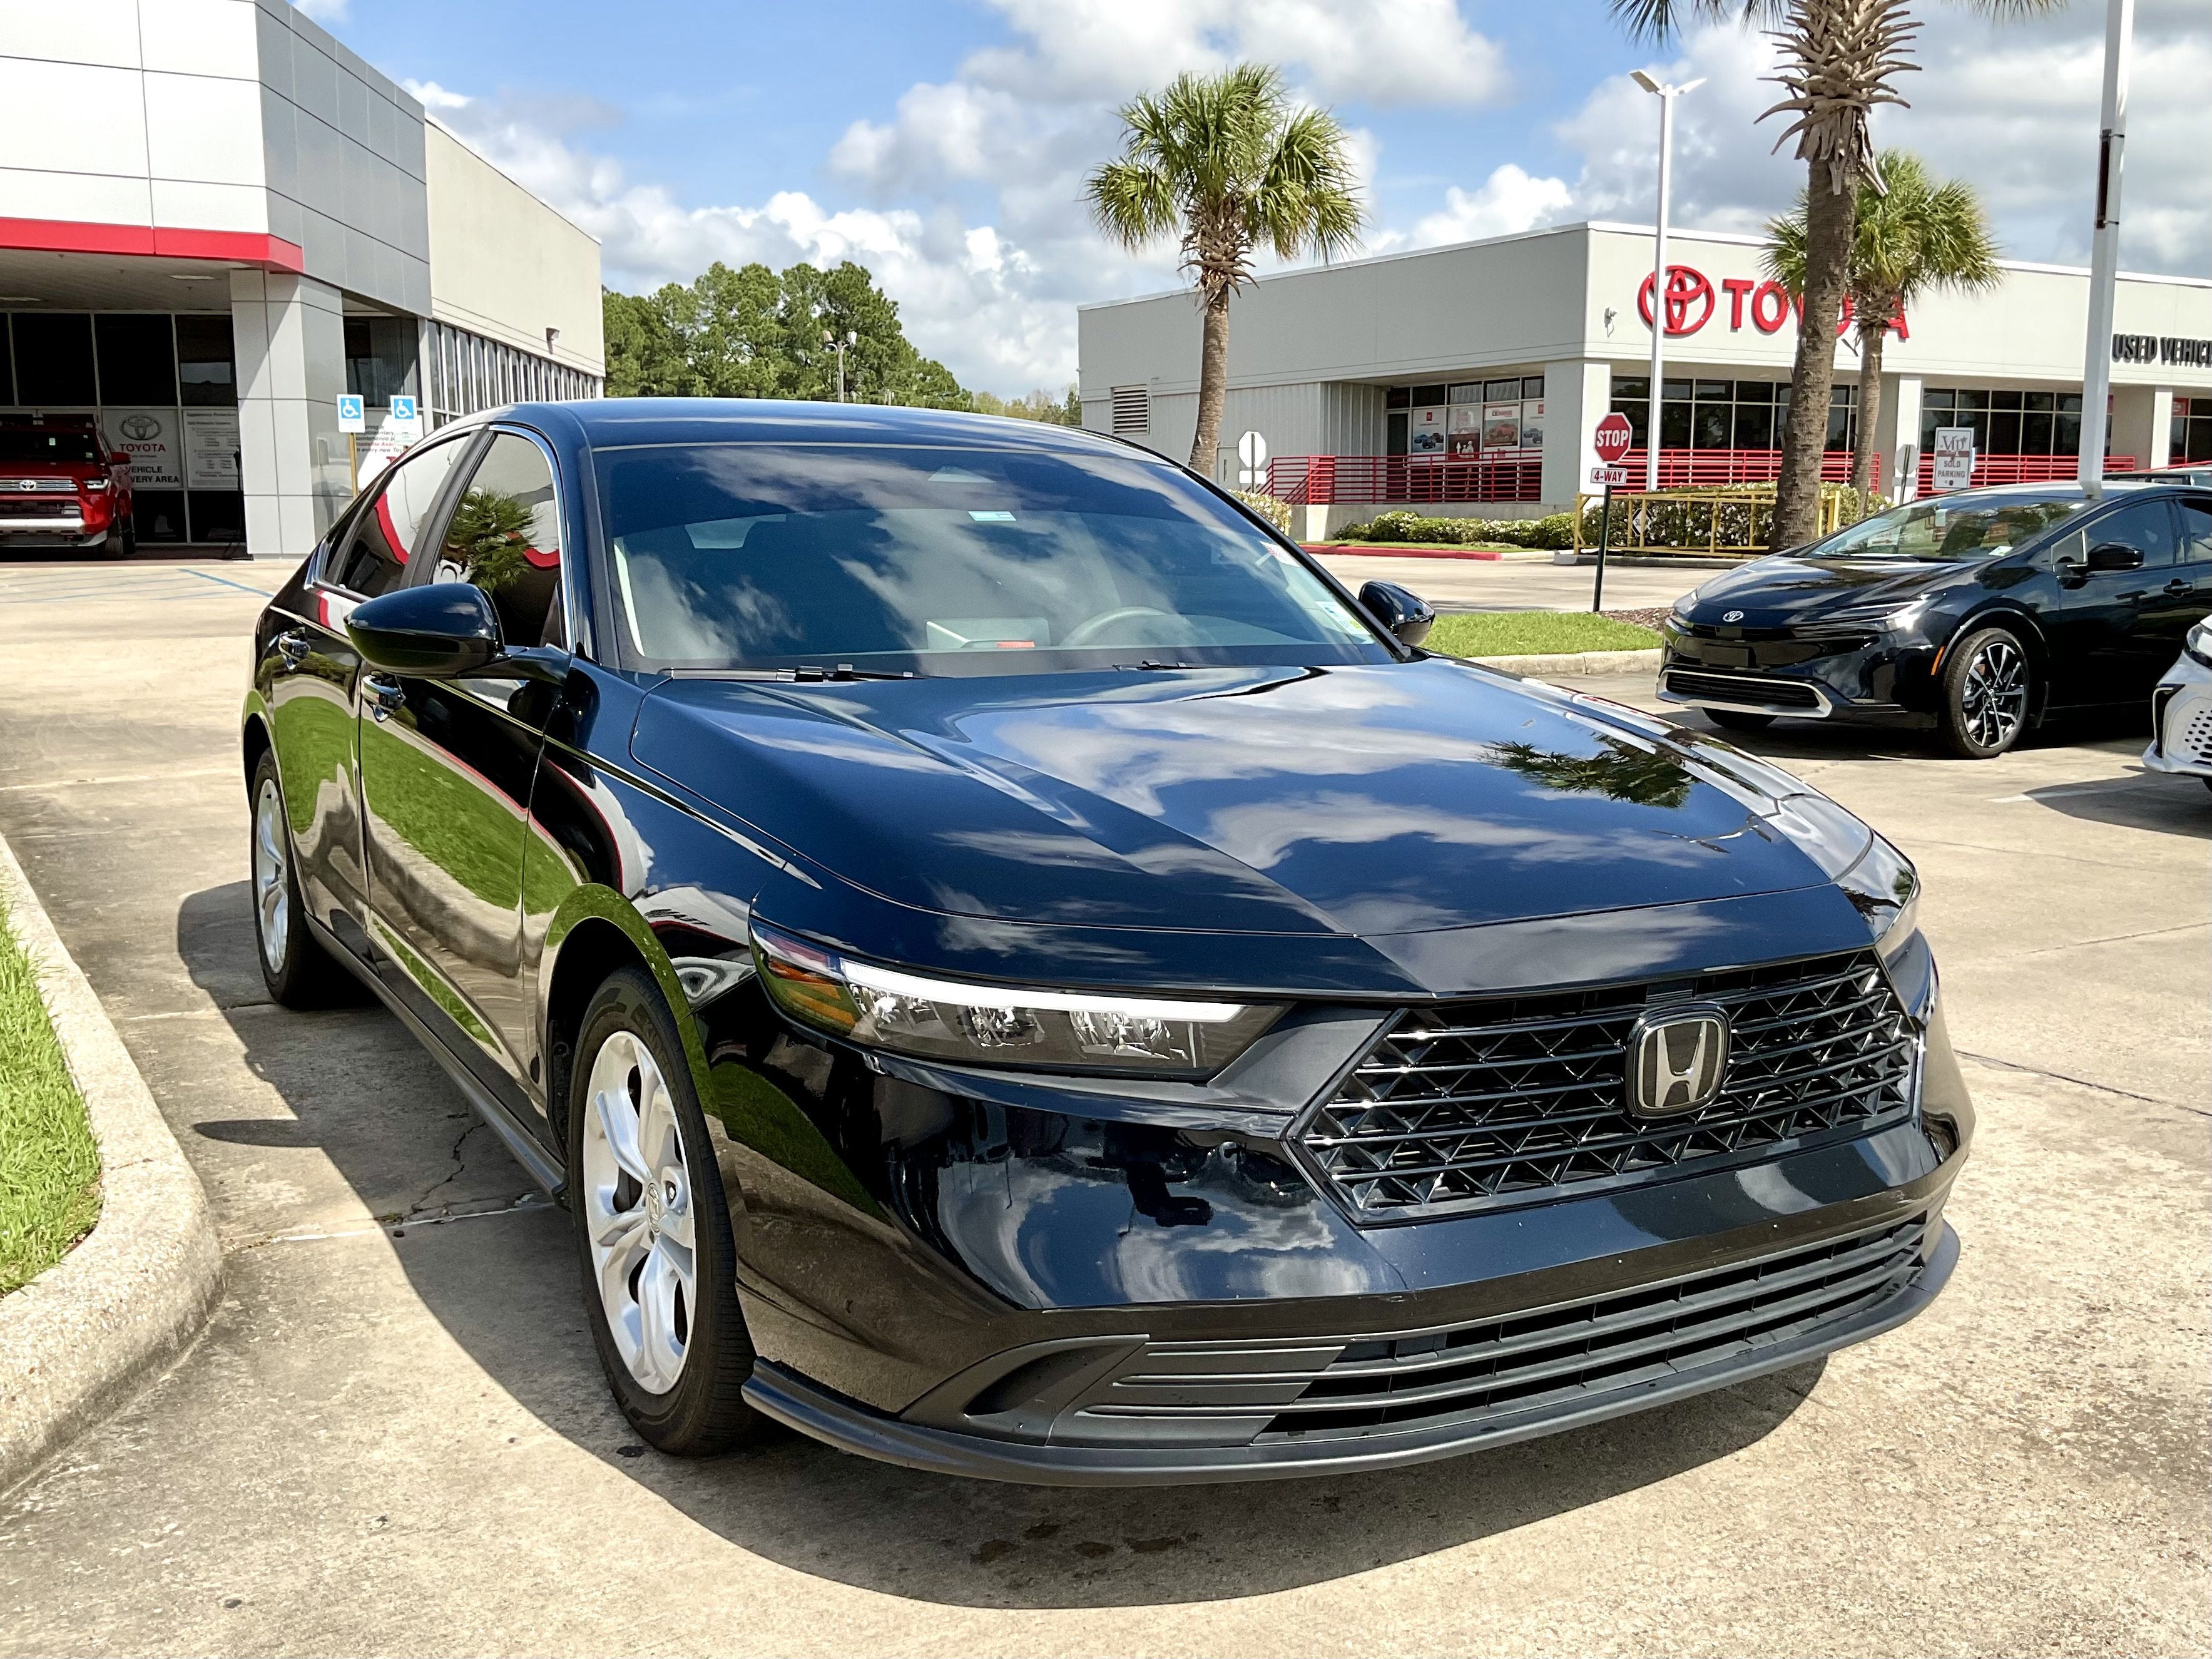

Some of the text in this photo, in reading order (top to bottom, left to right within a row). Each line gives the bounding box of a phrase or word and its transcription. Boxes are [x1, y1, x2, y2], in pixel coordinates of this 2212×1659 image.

[1723, 279, 1909, 339] TOA
[2113, 334, 2157, 361] USED
[1596, 429, 1629, 447] STOP
[119, 444, 166, 452] TOYOTA
[1594, 470, 1623, 482] 4-WAY
